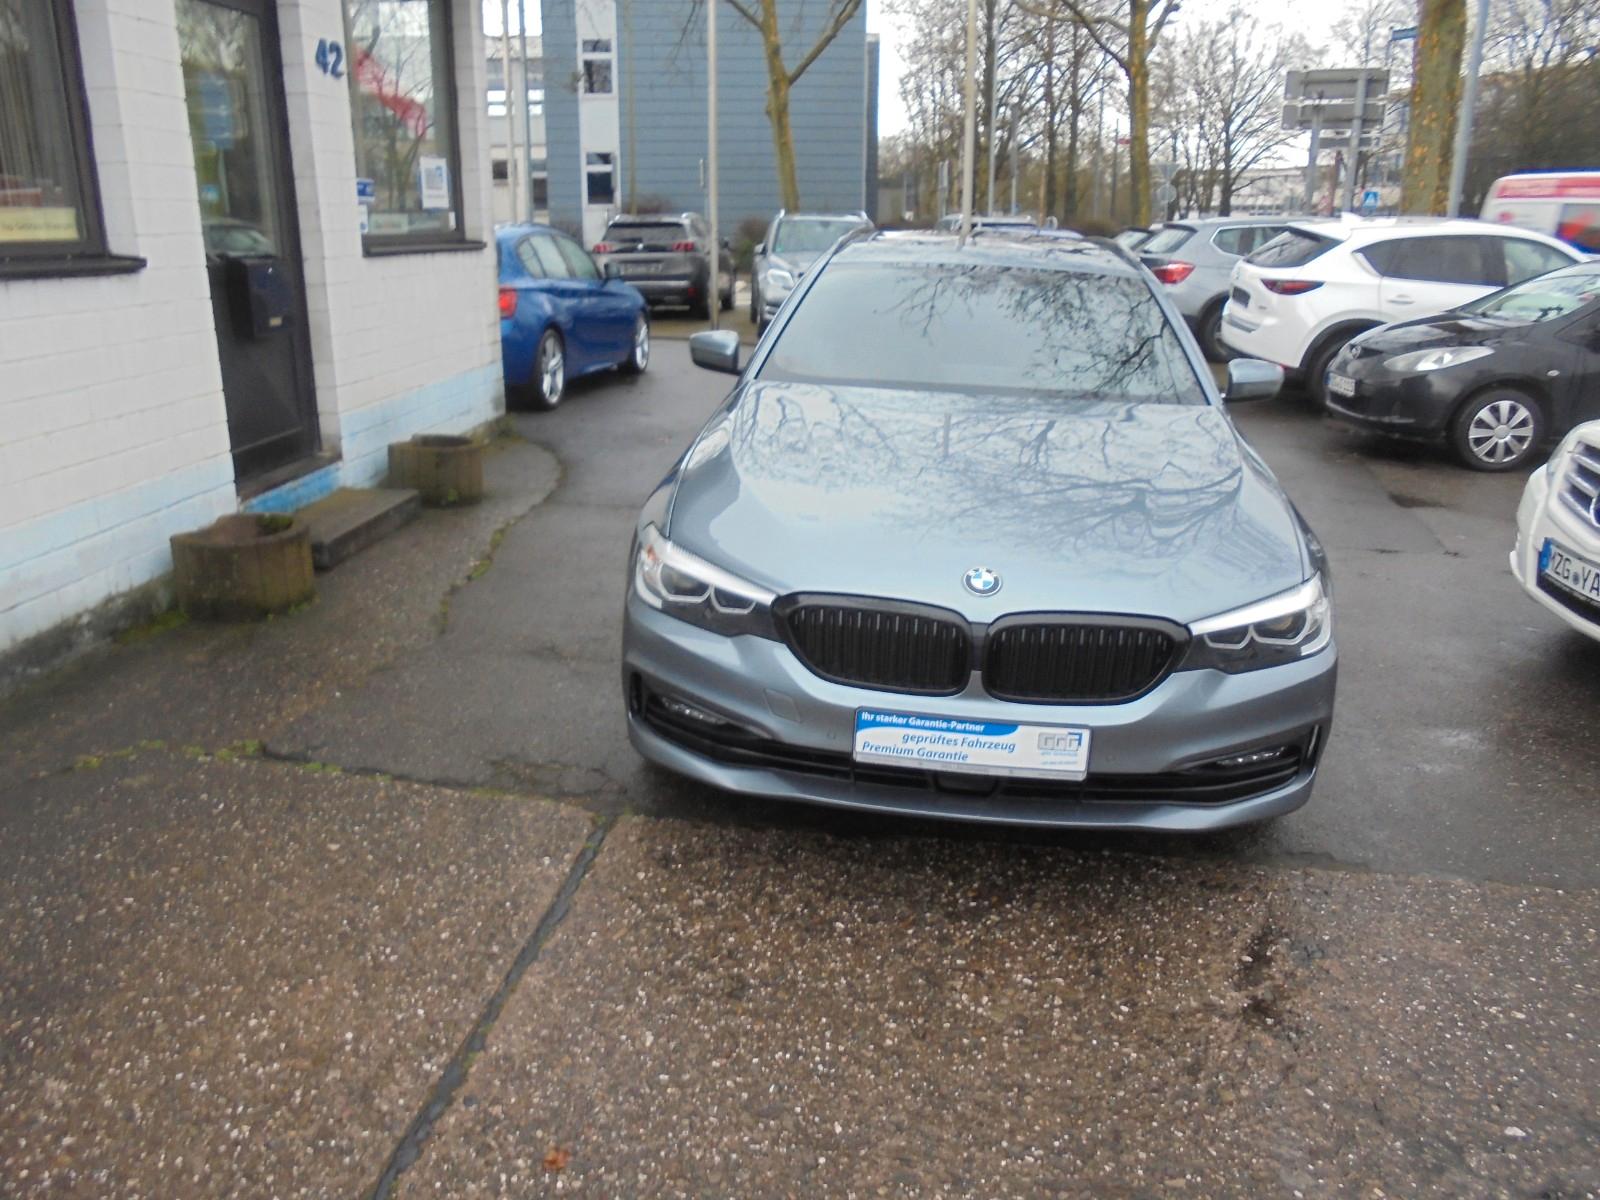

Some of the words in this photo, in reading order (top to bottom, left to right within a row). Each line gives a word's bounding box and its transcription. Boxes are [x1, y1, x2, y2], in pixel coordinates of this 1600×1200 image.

[315, 38, 344, 80] 42
[861, 711, 874, 721] Ihr
[876, 714, 908, 724] starker
[908, 716, 985, 732] Garantie-Partner
[862, 741, 914, 756] Premium
[917, 747, 969, 761] Garantie
[902, 733, 959, 747] geprüftes
[960, 736, 1016, 753] Fahrzeug
